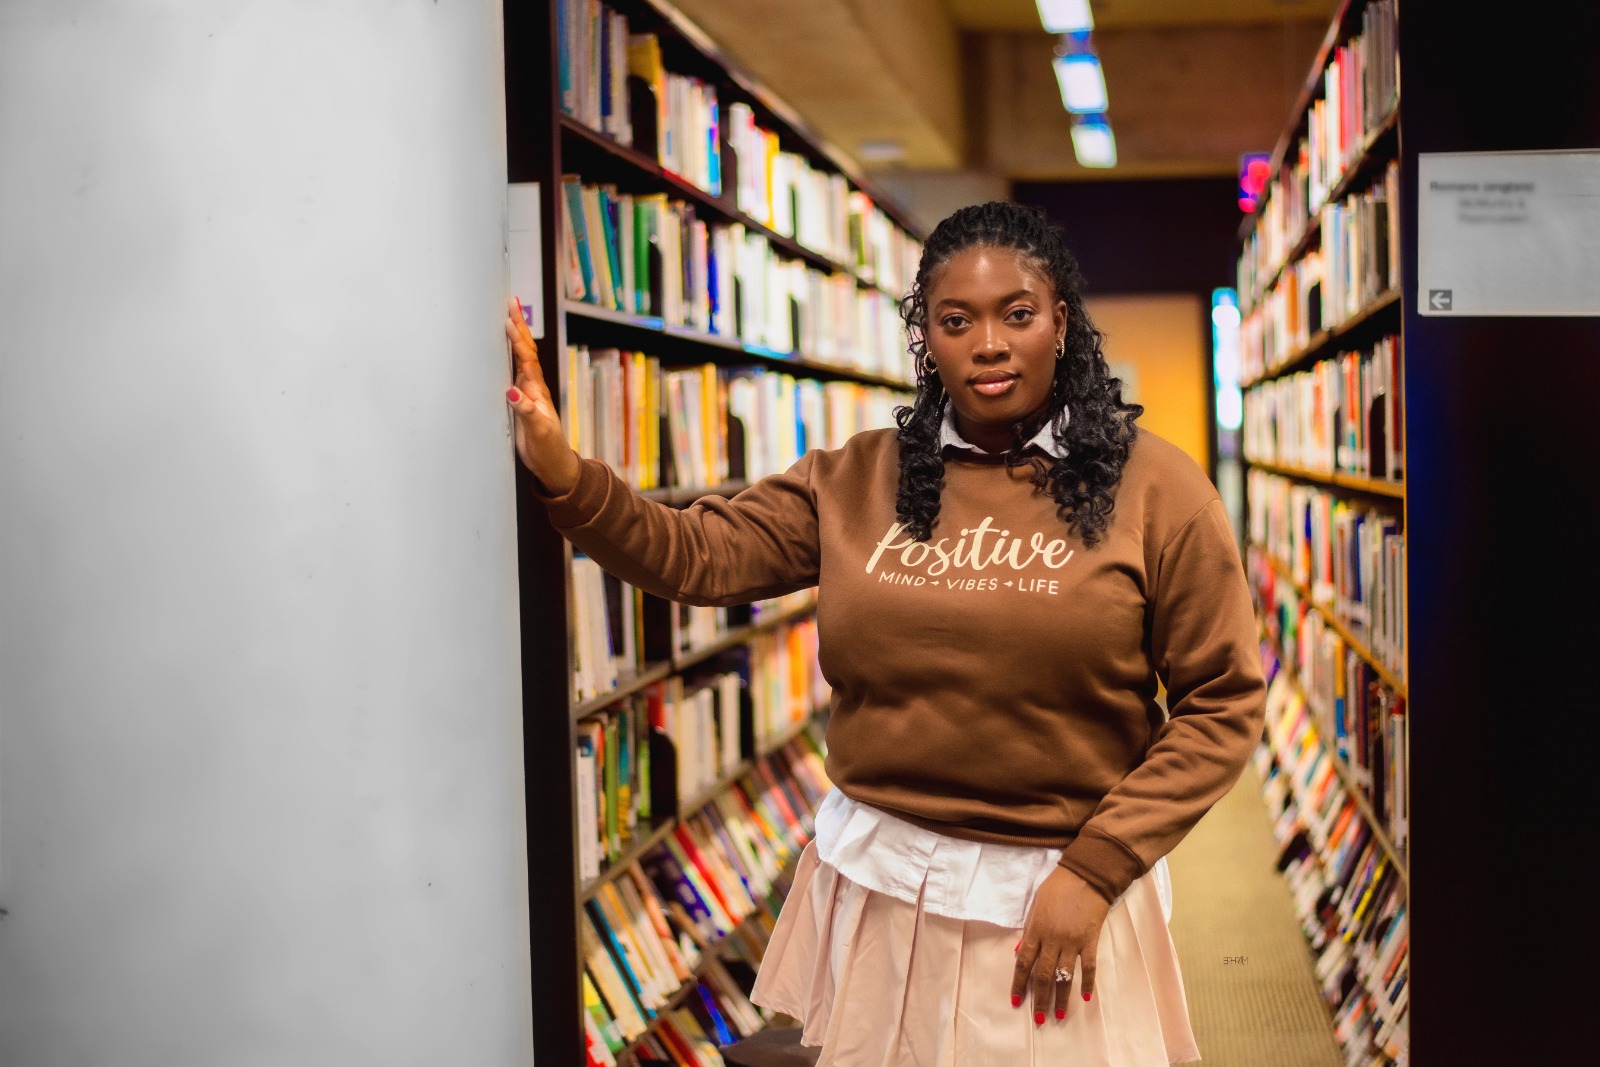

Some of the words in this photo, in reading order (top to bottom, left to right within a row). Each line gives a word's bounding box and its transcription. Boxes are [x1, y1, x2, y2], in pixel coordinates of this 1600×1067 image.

[865, 516, 1074, 576] Positive
[879, 571, 926, 587] MIND
[946, 578, 998, 591] VIBES
[1018, 578, 1059, 595] LIFE
